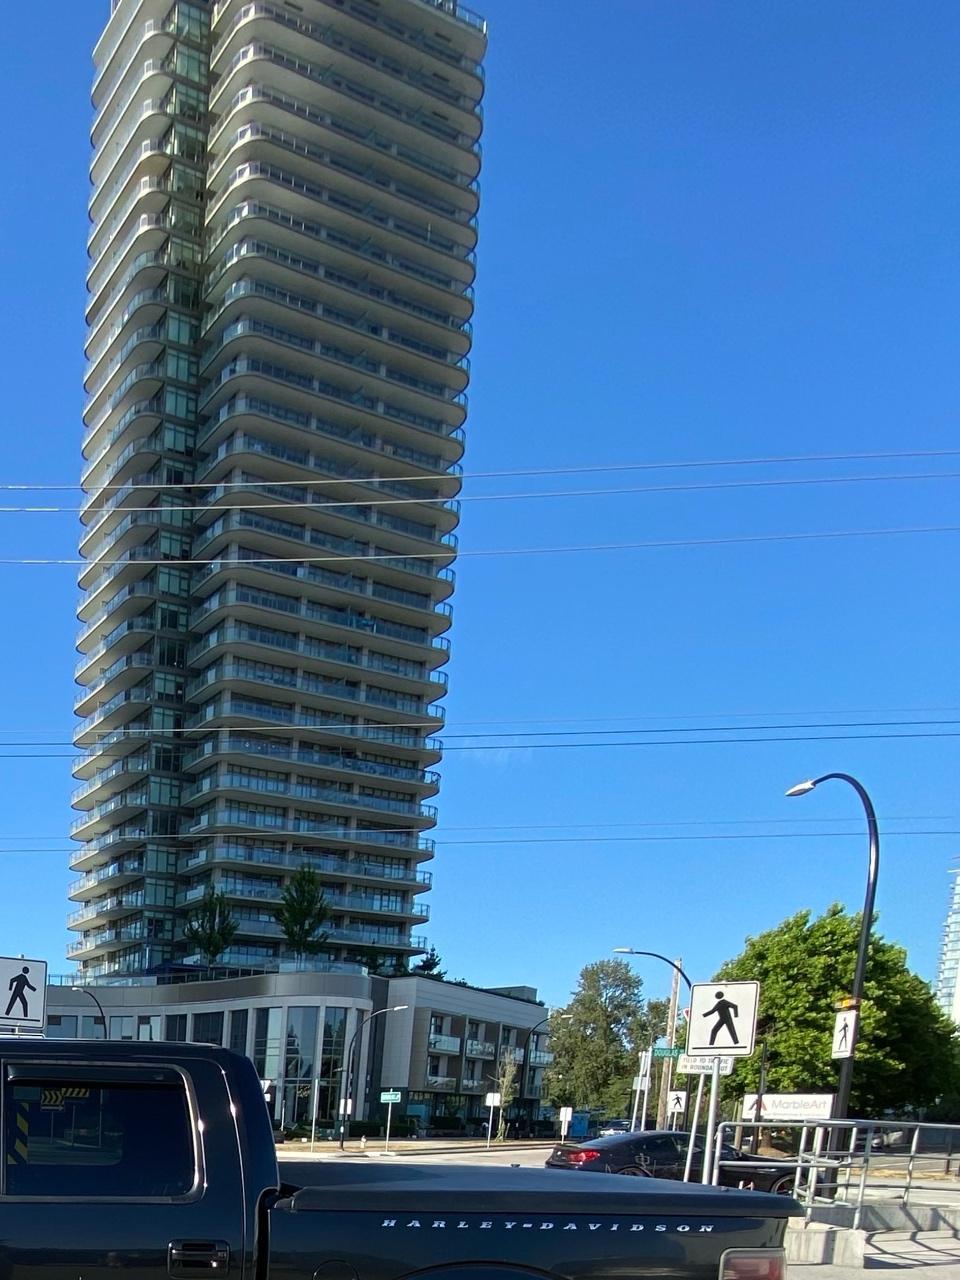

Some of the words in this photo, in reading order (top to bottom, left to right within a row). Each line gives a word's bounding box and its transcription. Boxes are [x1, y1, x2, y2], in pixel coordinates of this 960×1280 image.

[654, 1049, 678, 1057] DOUGLAS
[689, 1064, 728, 1072] ROUNDAUT
[771, 1099, 827, 1109] MarbleArt
[381, 1218, 715, 1232] HARLEY-DAVIDSON
